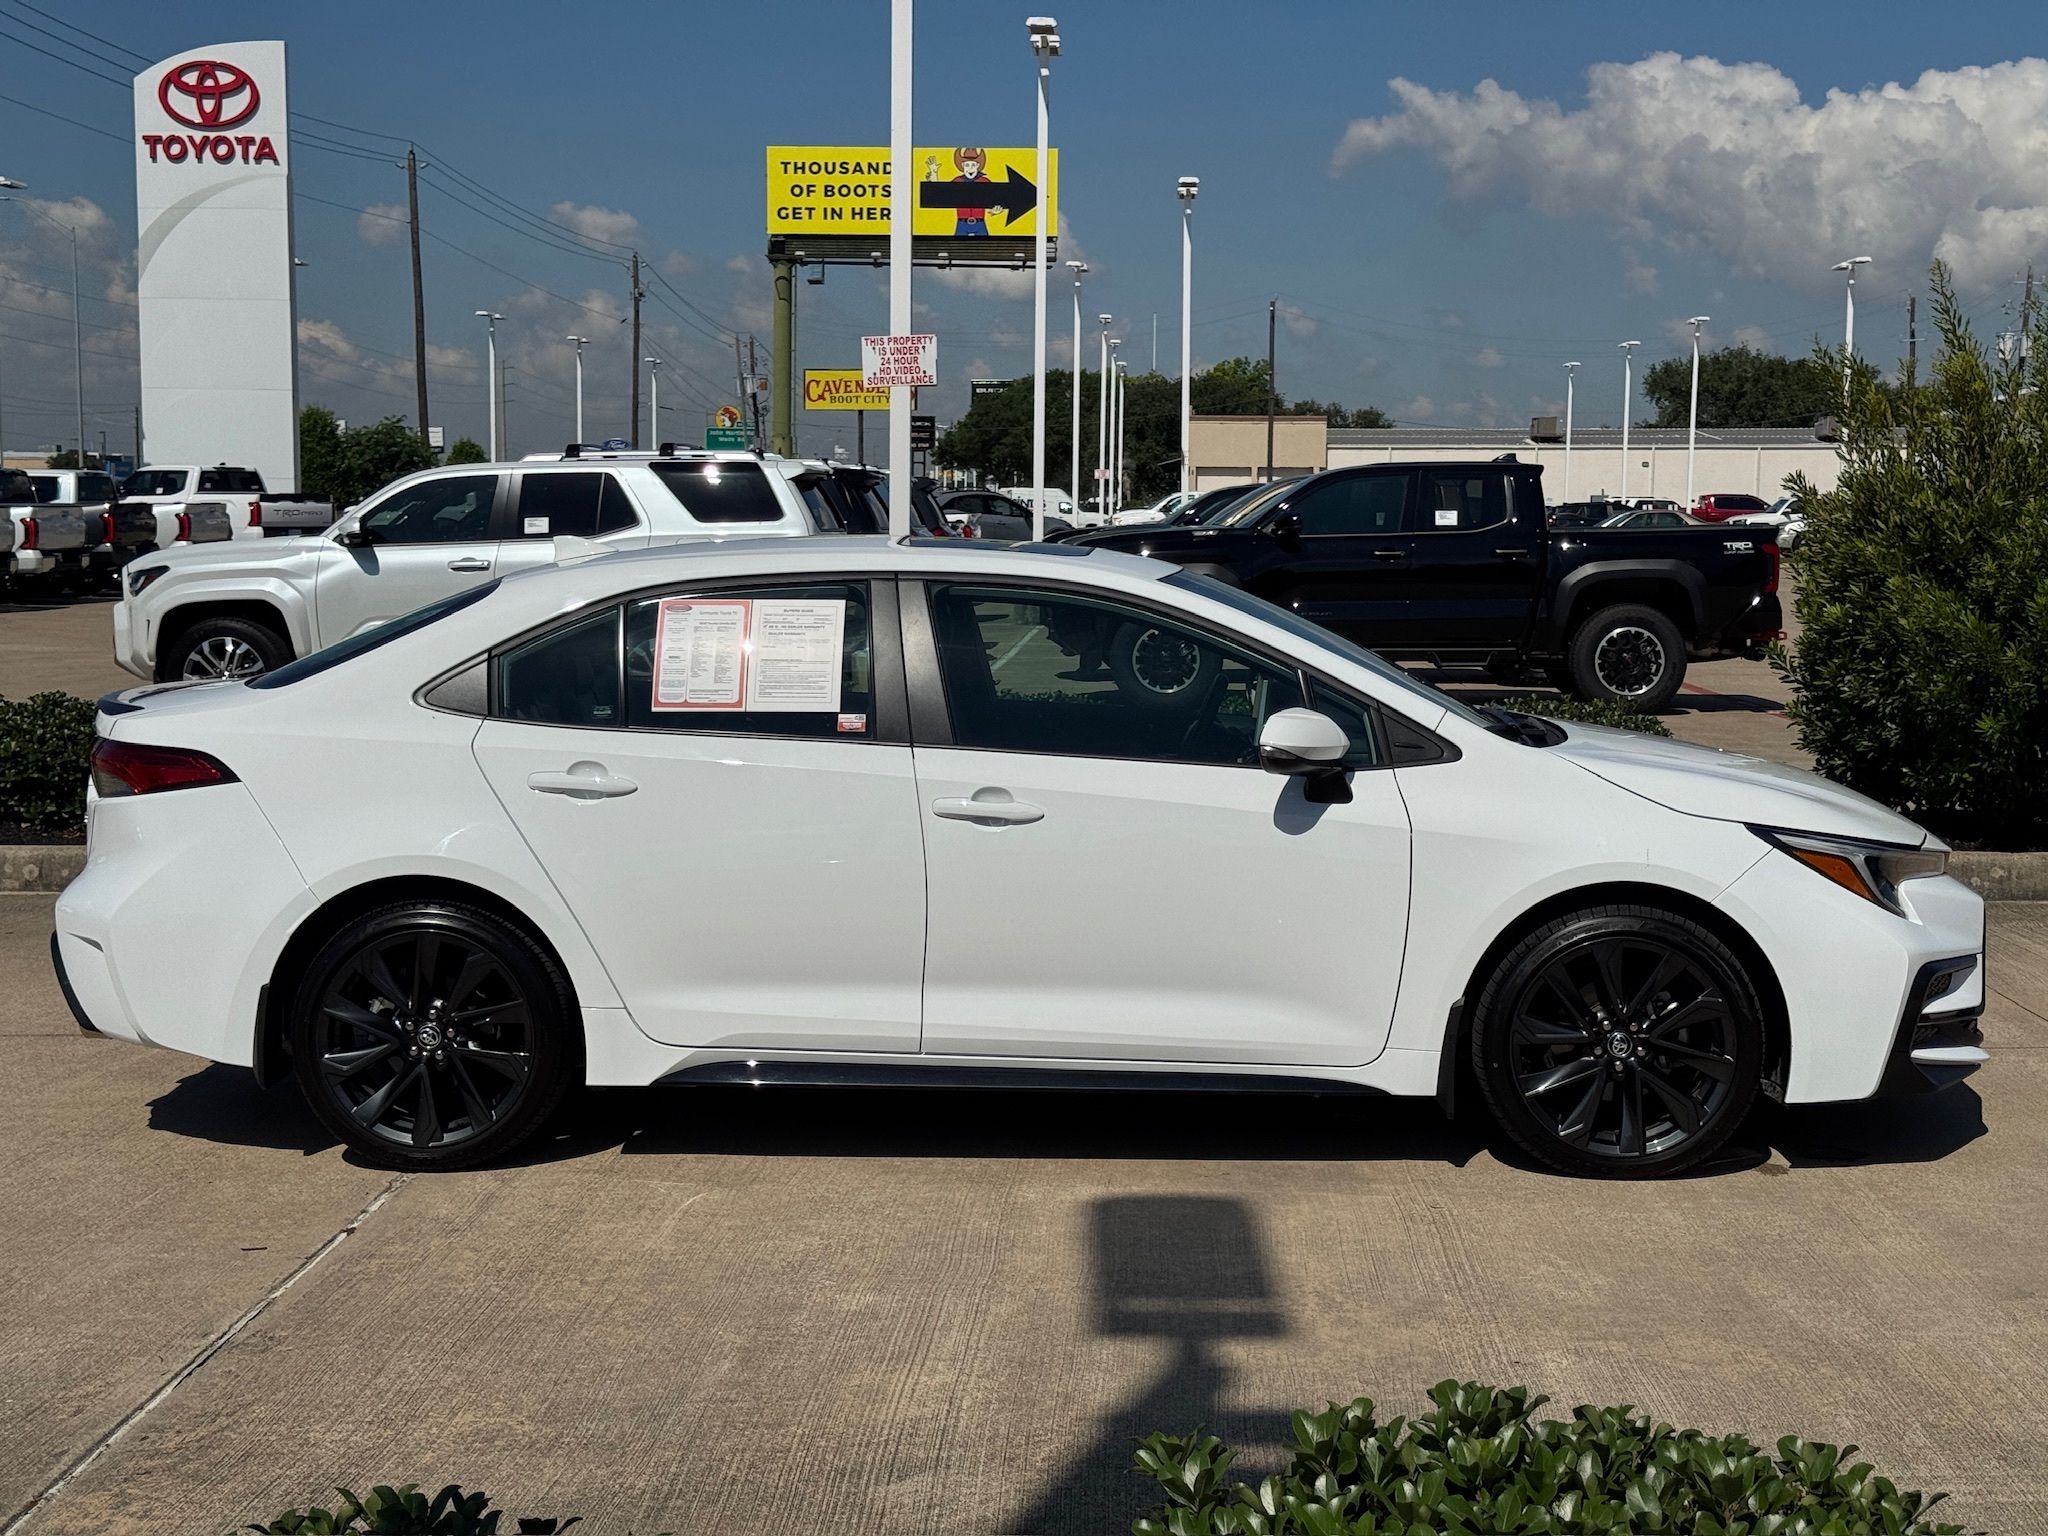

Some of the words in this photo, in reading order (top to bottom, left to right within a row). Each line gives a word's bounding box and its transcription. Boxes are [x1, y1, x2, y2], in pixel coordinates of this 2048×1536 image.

[142, 135, 279, 164] TOYOTA
[780, 161, 891, 175] THOUSAND
[790, 184, 816, 198] OF
[824, 184, 891, 198] BOOTS
[777, 206, 816, 220] GET
[823, 207, 842, 220] IN
[851, 207, 891, 220] HER
[864, 337, 885, 347] THIS
[887, 336, 934, 346] PROPERTY
[878, 347, 887, 356] IS
[889, 346, 920, 356] UNDER
[880, 357, 891, 366] 24
[893, 357, 919, 366] HOUR
[879, 367, 892, 376] HD
[894, 366, 921, 375] VIDEO
[867, 375, 934, 386] SURVEILLANCE
[829, 395, 862, 404] BOOT
[863, 395, 890, 404] CITY
[1723, 541, 1753, 551] TRD
